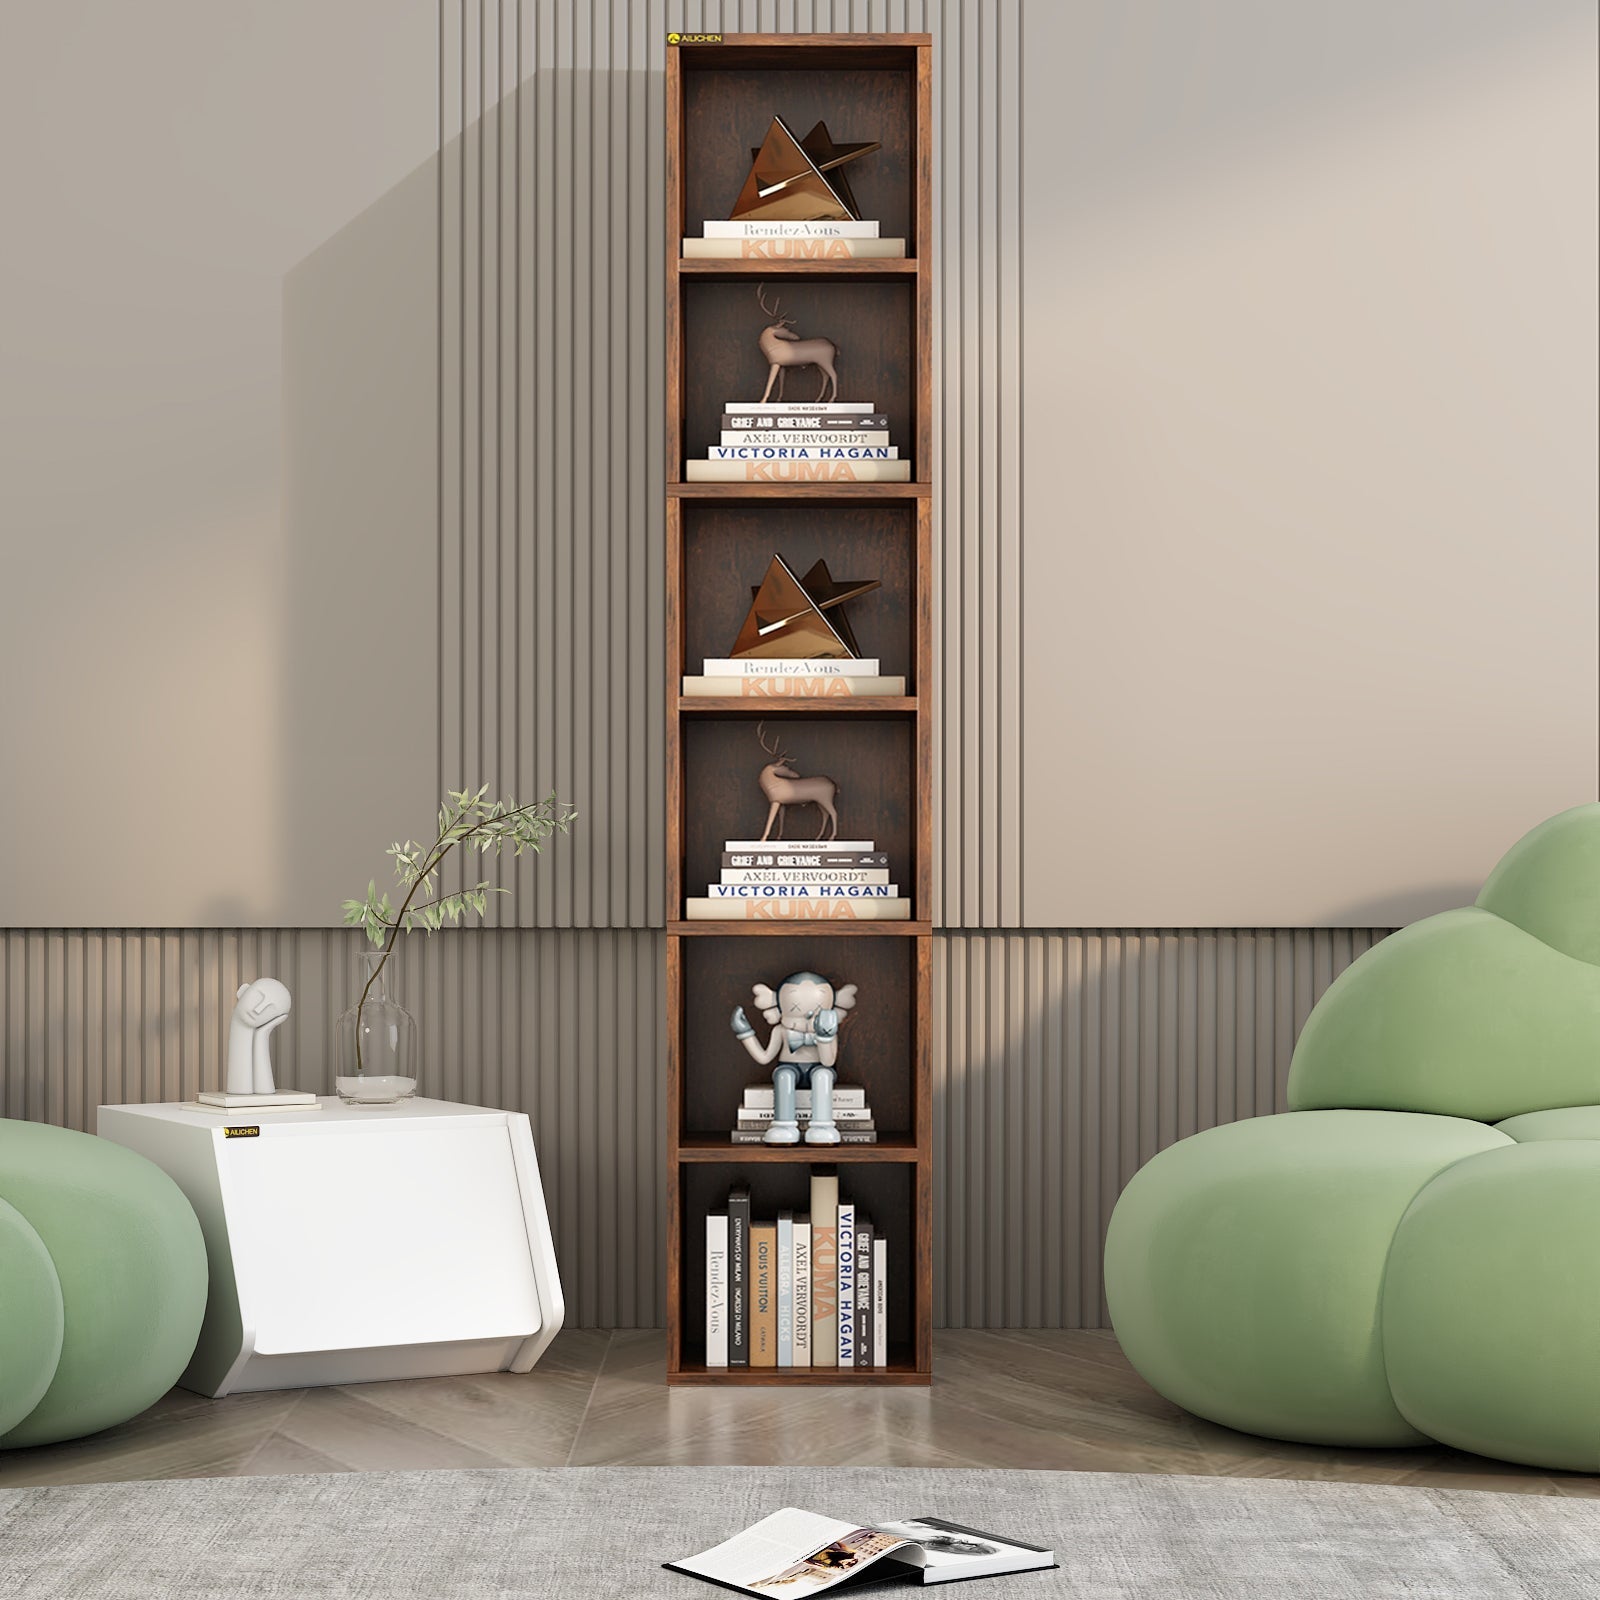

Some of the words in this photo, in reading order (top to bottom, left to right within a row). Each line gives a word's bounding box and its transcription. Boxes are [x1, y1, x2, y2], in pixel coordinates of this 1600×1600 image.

[743, 223, 841, 236] Rendez-Vous
[741, 239, 853, 259] KUMA
[731, 417, 754, 429] GRIEF
[756, 417, 773, 428] AND
[777, 417, 821, 429] GRIEVANCE
[743, 434, 780, 443] AXEL
[783, 434, 868, 443] VERVOORDT
[717, 448, 809, 458] VICTORIA
[820, 448, 888, 458] HAGAN
[745, 462, 857, 481] KUMA
[743, 661, 841, 674] Rendez-Vous
[741, 677, 853, 697] KUMA
[731, 855, 754, 867] GRIEF
[756, 855, 773, 866] AND
[777, 855, 821, 867] GRIEVANCE
[743, 872, 780, 881] AXEL
[783, 872, 868, 881] VERVOORDT
[717, 886, 809, 896] VICTORIA
[820, 886, 888, 896] HAGAN
[745, 900, 857, 919] KUMA
[840, 1213, 852, 1291] VICTORIA
[857, 1233, 869, 1253] GRIEF
[758, 1241, 768, 1270] LOUIS
[796, 1243, 807, 1274] AXEL
[858, 1255, 869, 1269] AND
[780, 1245, 790, 1296] ALLEGRA
[814, 1226, 836, 1321] KUMA
[711, 1250, 724, 1333] Rendez-Vous
[758, 1272, 768, 1313] VUITTON
[857, 1272, 869, 1310] GRIEVANCE
[796, 1276, 807, 1348] VERVOORDT
[780, 1305, 790, 1342] HICKS
[840, 1301, 852, 1358] HAGAN
